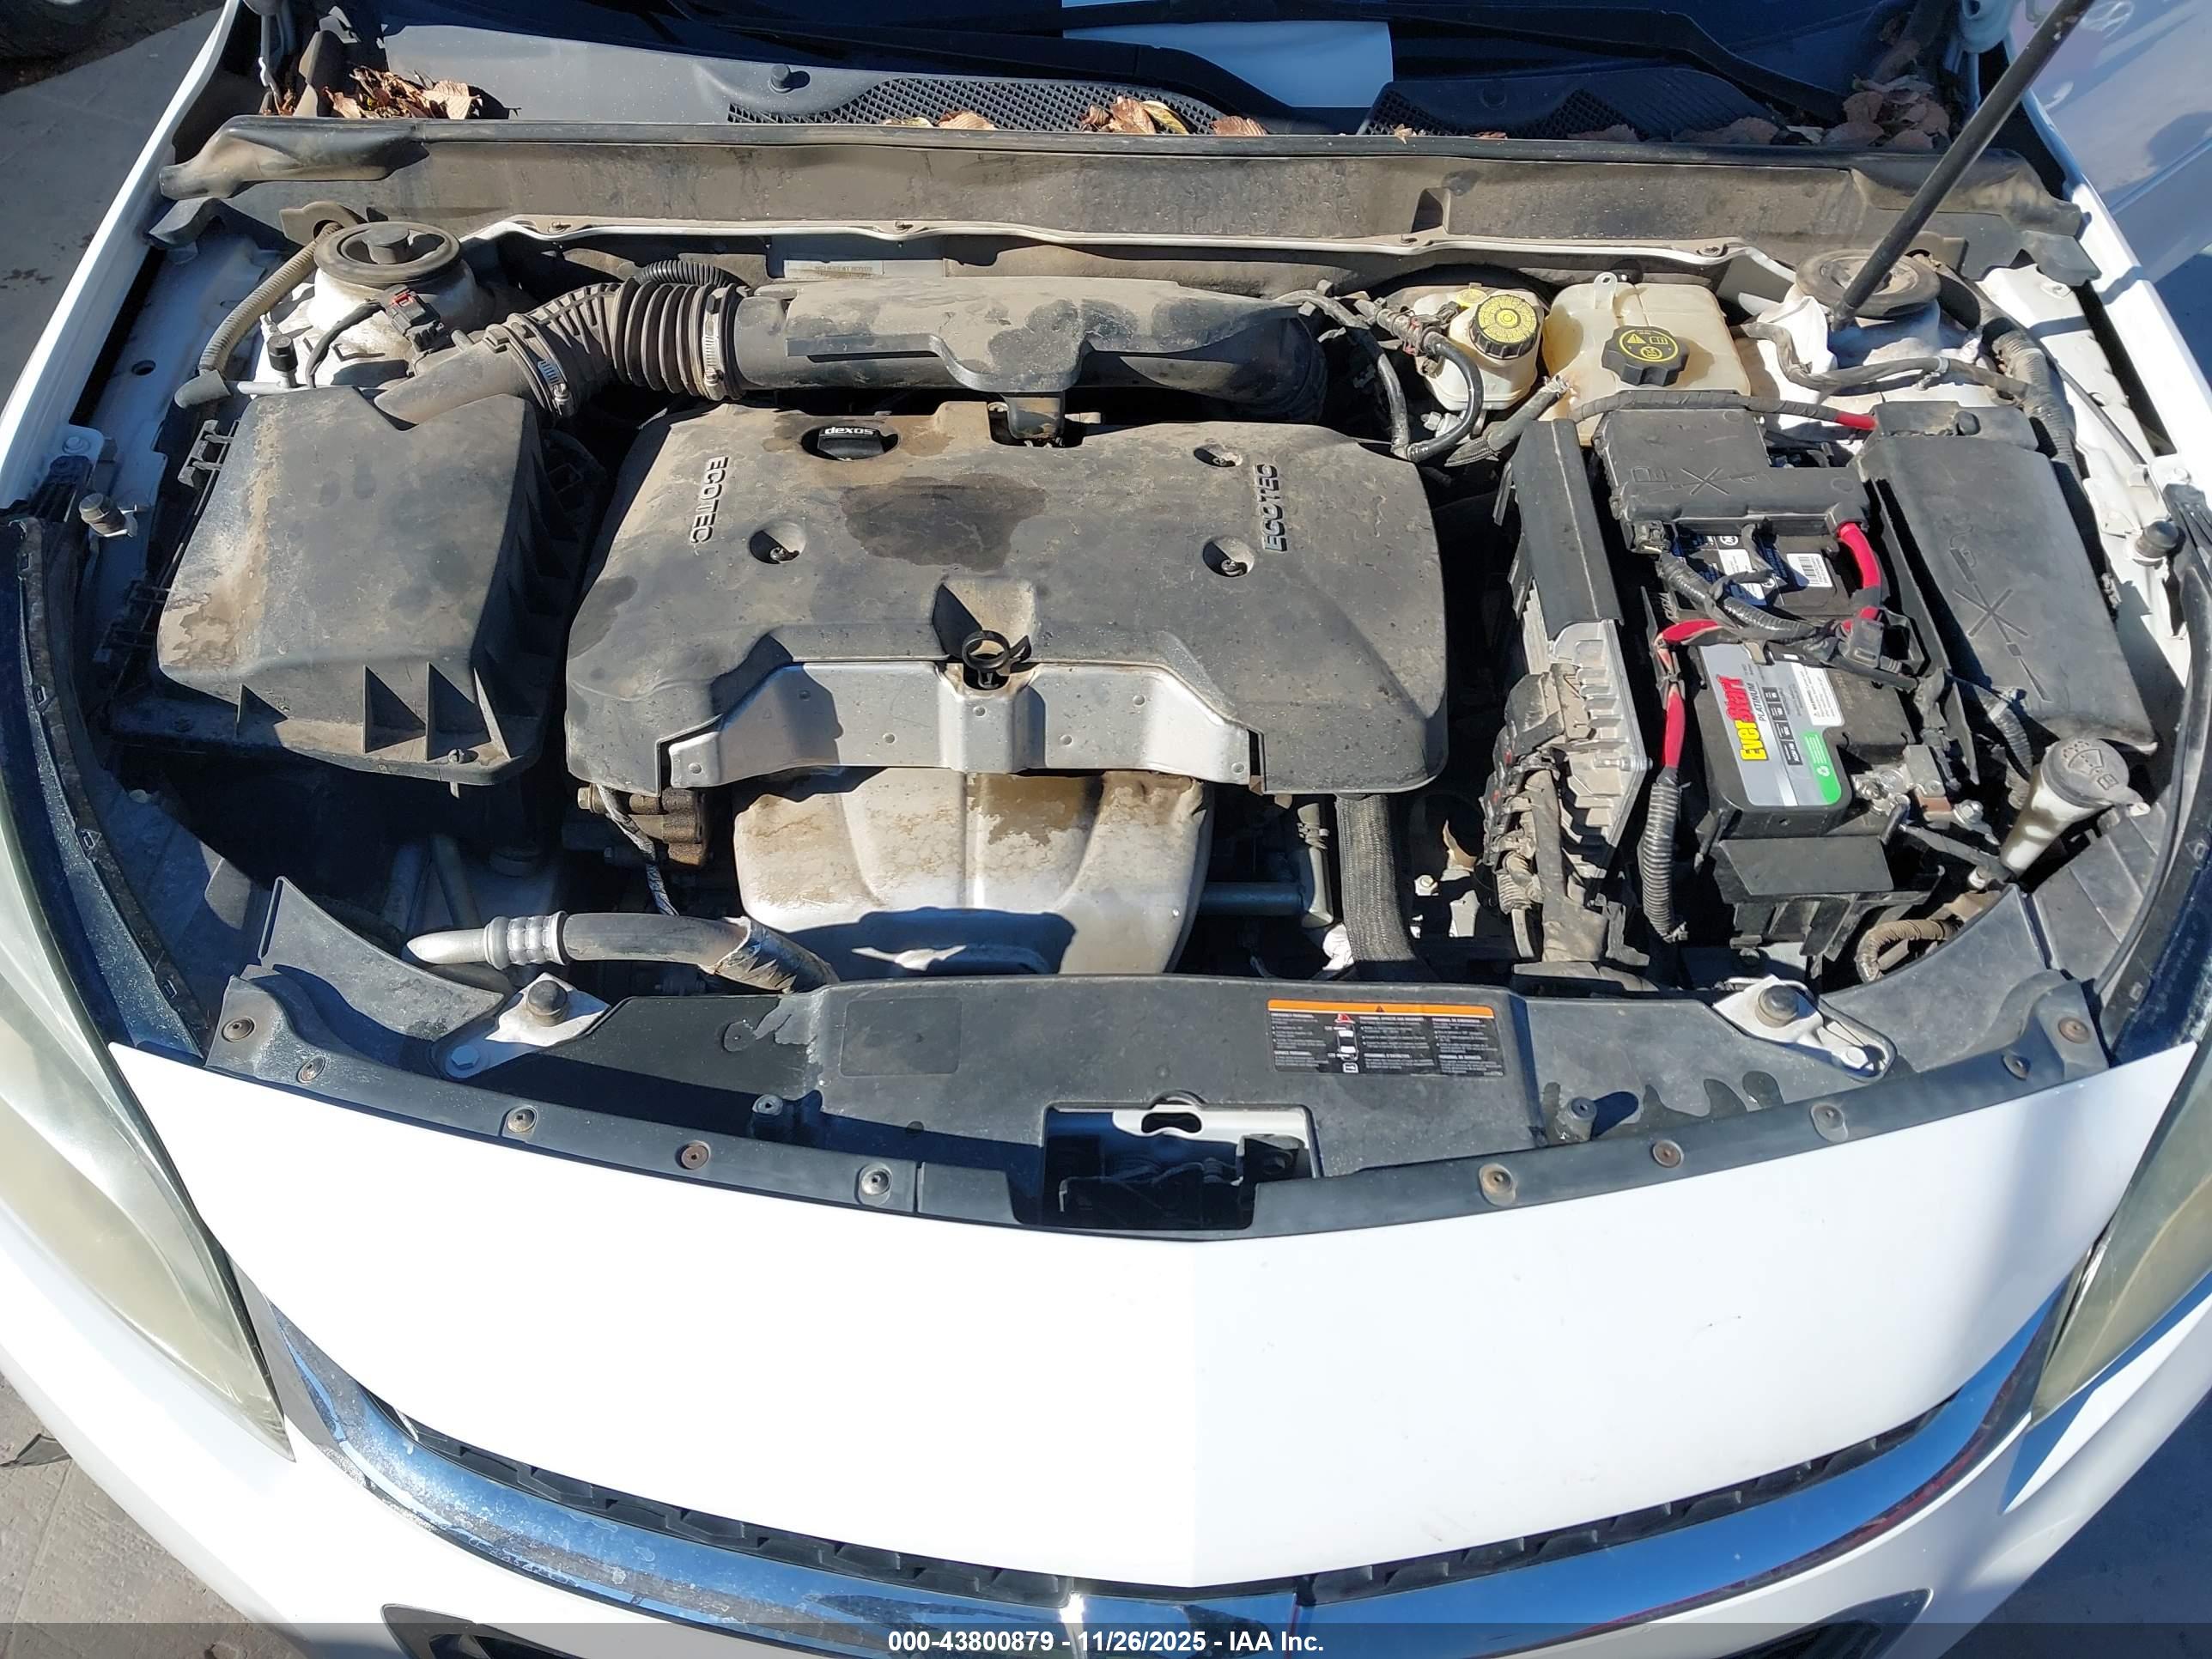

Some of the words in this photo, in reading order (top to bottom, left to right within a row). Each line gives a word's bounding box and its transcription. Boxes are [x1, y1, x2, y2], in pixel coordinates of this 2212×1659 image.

[824, 427, 875, 435] dexos
[690, 456, 730, 544] ECOTEC
[1253, 464, 1288, 552] ECOTEC
[1717, 674, 1769, 761] EverStart
[1746, 682, 1767, 722] PLATINUM
